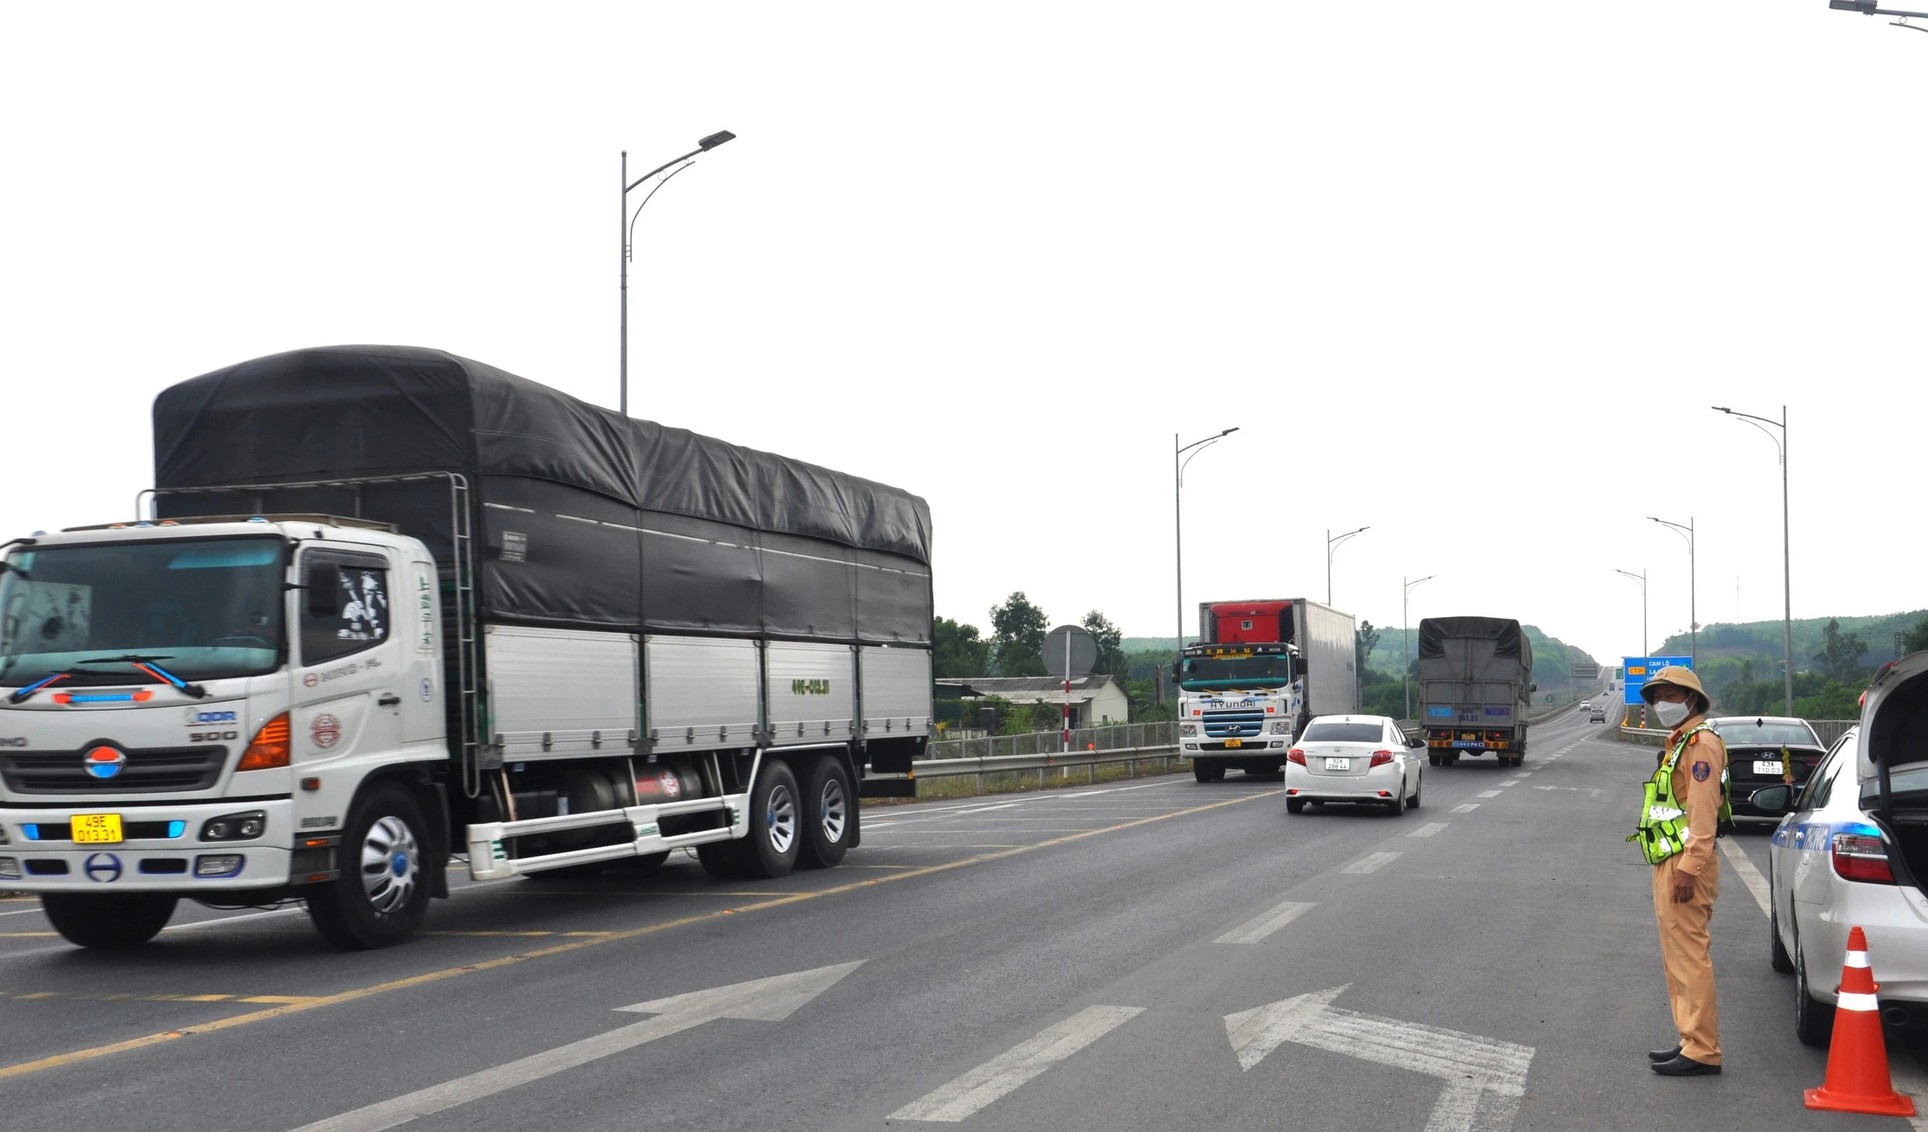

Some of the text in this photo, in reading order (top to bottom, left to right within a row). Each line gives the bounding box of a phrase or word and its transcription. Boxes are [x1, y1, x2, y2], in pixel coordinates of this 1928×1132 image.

[1210, 700, 1256, 709] HYUNDAI
[189, 731, 238, 742] 500
[86, 816, 107, 828] 49E
